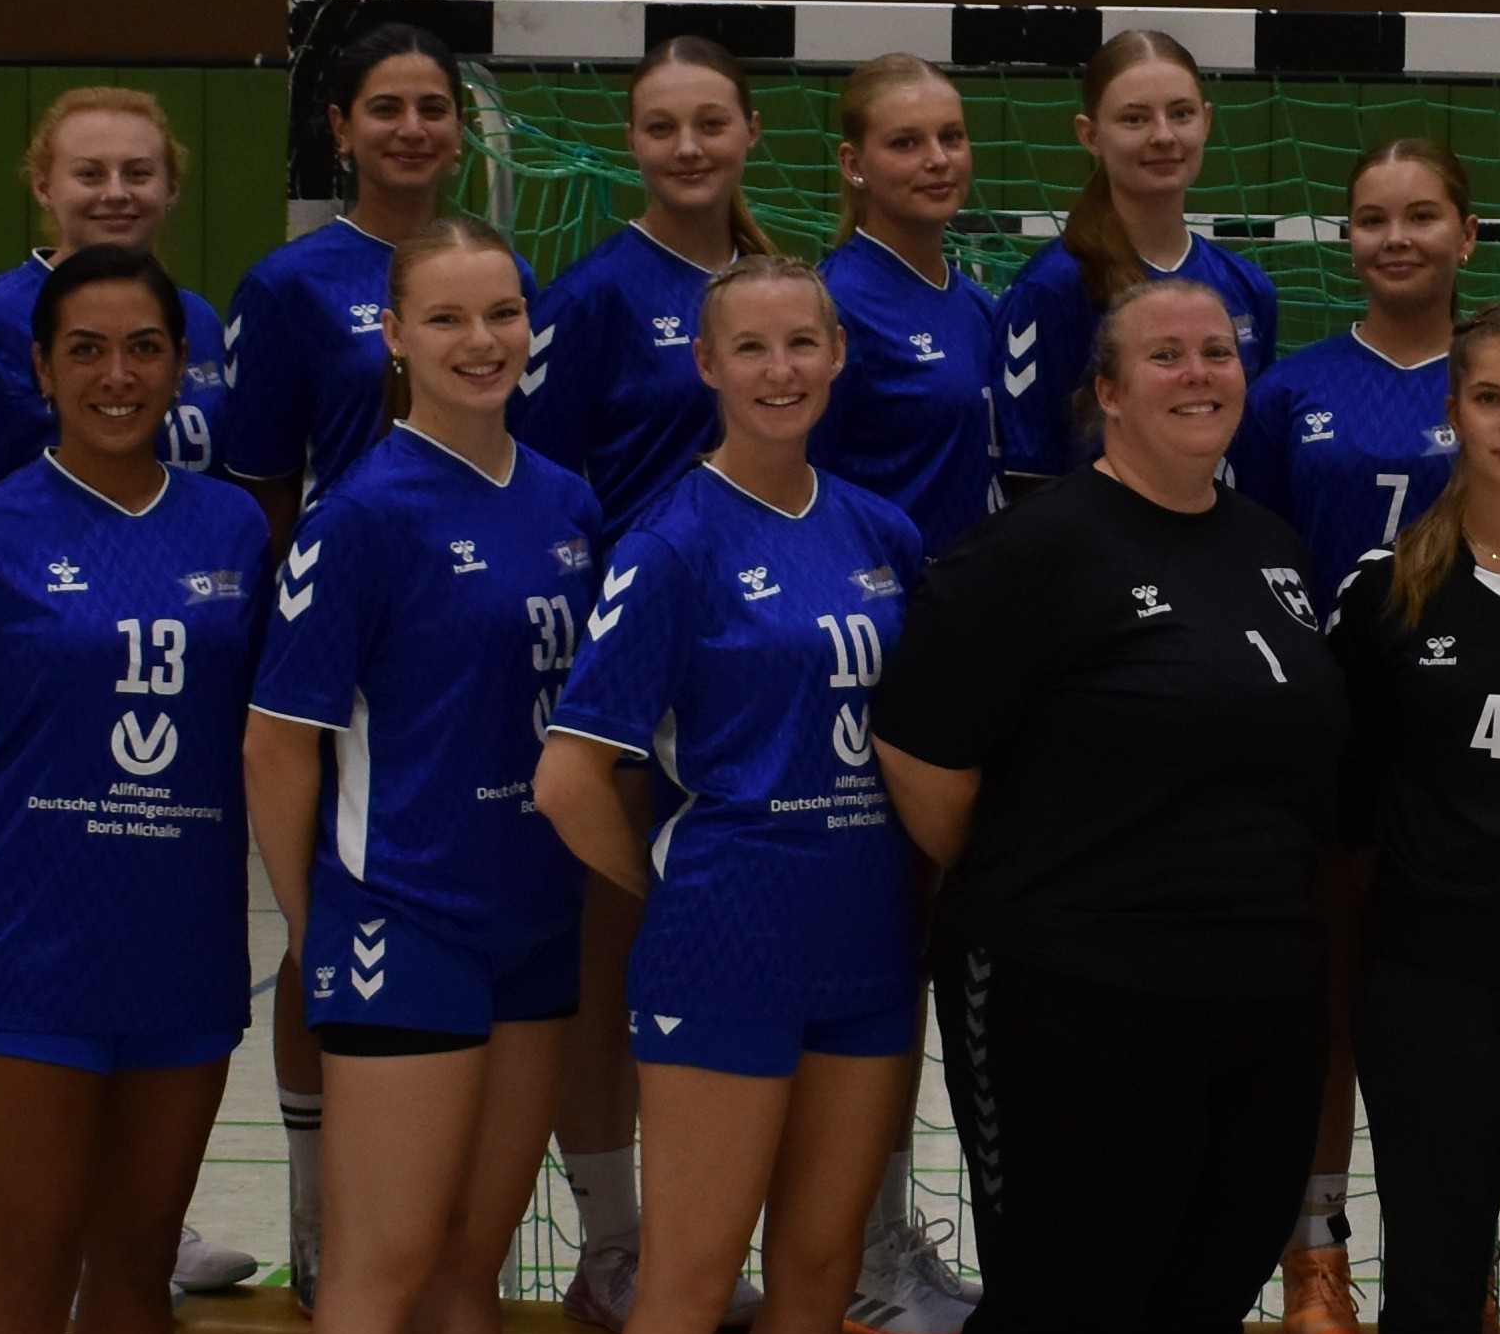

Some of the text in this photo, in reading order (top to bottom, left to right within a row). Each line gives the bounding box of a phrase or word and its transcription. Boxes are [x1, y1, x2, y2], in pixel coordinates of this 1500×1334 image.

[1375, 473, 1410, 546] 7
[114, 618, 187, 696] 13
[526, 594, 576, 672] 31
[816, 613, 883, 688] 10
[1244, 629, 1289, 684] 1
[27, 795, 97, 813] Deutsche
[108, 782, 172, 800] Allfinanz
[87, 819, 123, 835] Boris
